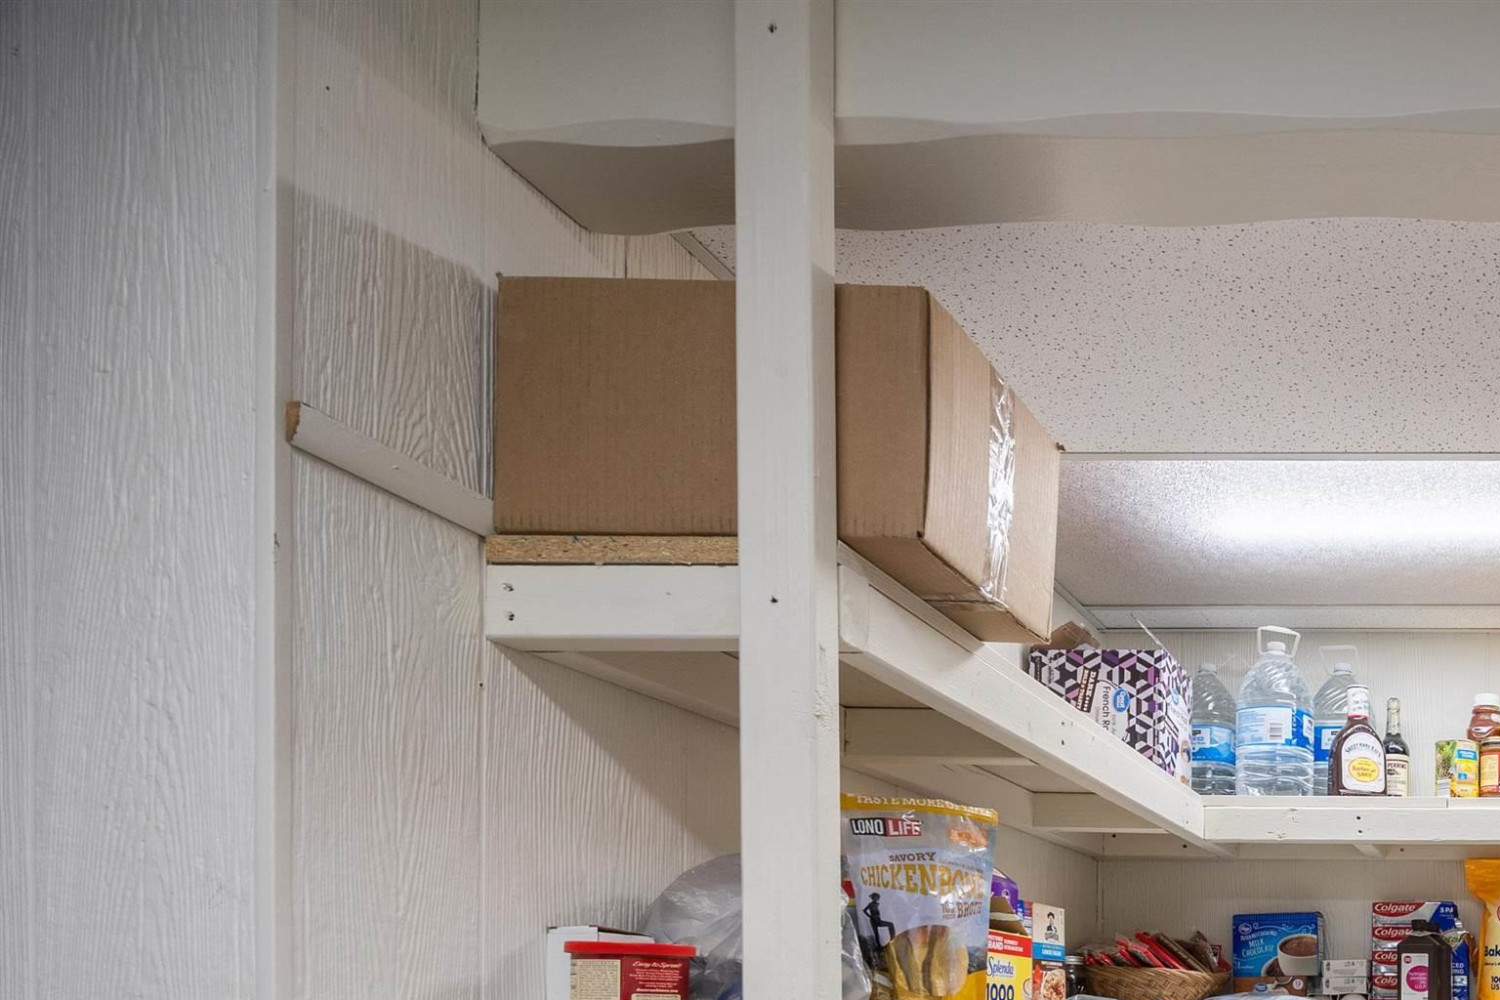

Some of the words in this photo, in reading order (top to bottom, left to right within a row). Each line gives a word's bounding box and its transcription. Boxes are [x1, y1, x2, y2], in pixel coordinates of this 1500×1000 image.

[851, 819, 885, 835] LONO
[888, 819, 923, 836] LIFE
[889, 852, 937, 862] SAVORY
[860, 863, 938, 896] CHICKEN
[1374, 902, 1416, 914] Colgate
